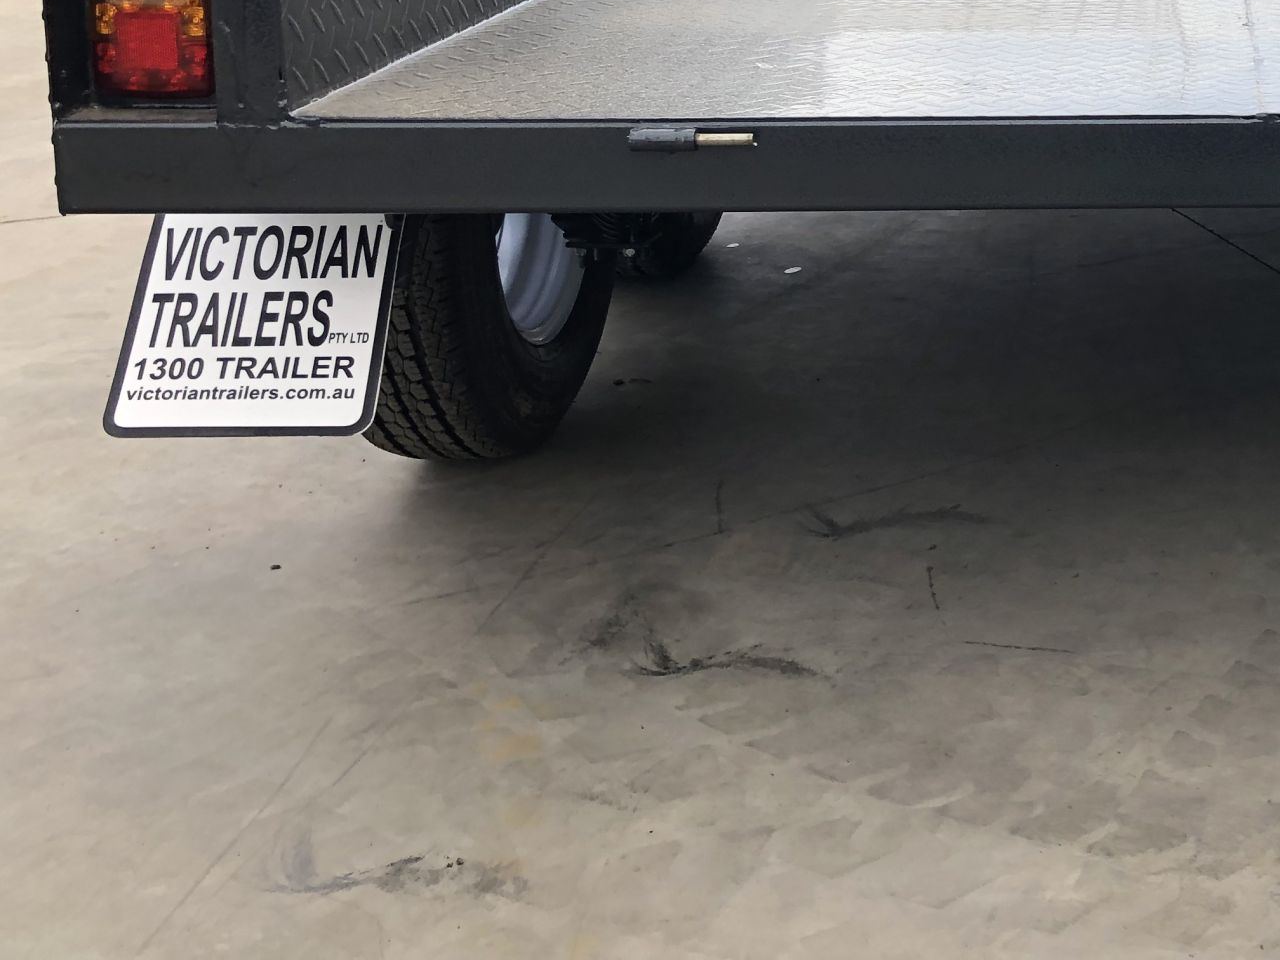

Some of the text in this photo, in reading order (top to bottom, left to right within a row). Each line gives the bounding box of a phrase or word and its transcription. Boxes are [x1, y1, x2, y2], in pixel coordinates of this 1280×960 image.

[165, 225, 383, 281] VICTORIAN
[149, 290, 369, 348] TRAILERS PTY LTD
[133, 356, 355, 380] 1300 TRAILER
[126, 386, 355, 401] victoriantrailers.com.au
